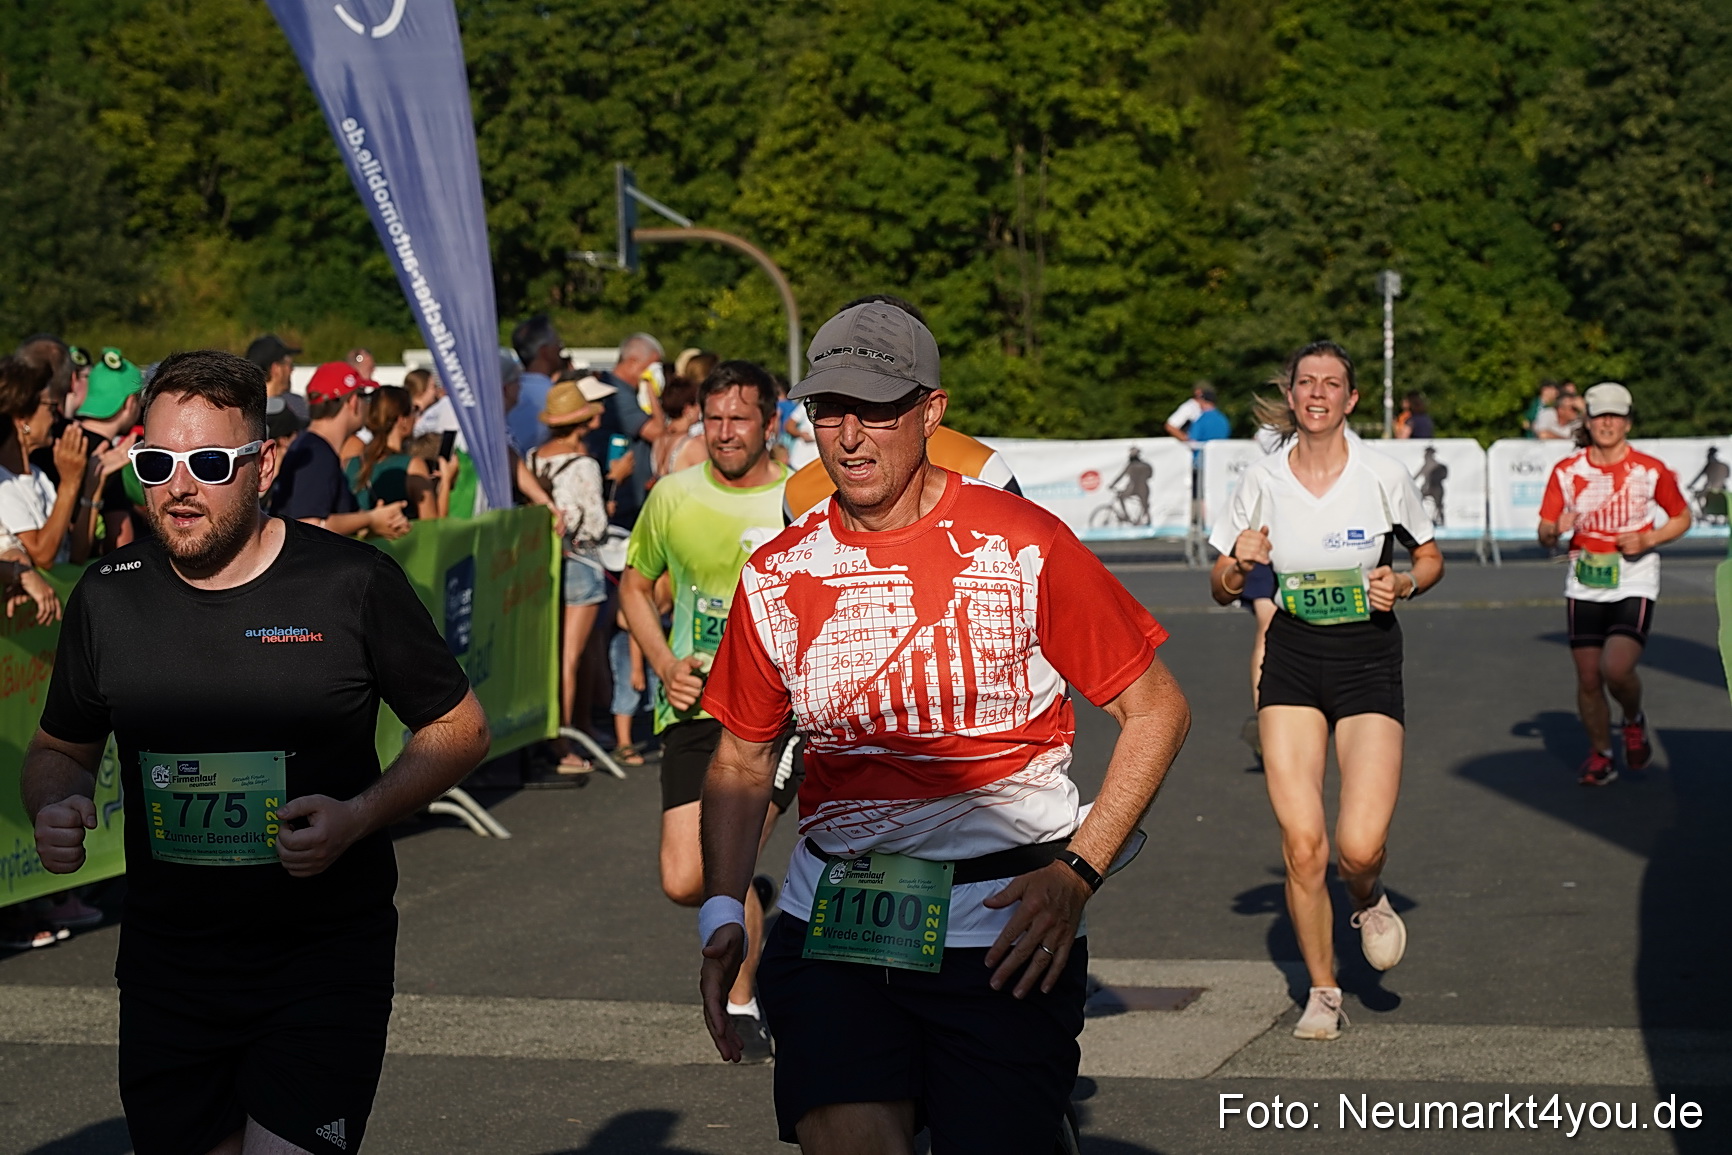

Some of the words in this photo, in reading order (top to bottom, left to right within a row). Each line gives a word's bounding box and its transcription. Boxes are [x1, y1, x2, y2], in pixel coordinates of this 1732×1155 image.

[813, 346, 854, 363] SILVER
[857, 347, 896, 364] STAR
[114, 560, 142, 572] JAKO
[832, 559, 868, 576] 10.54
[970, 560, 1020, 577] 91.62%
[1303, 586, 1346, 607] 516
[245, 626, 309, 637] autoladen
[261, 632, 323, 643] neumarkt
[831, 628, 872, 646] 52.01
[831, 651, 874, 670] 26.22
[172, 772, 217, 784] Firmenlauf
[188, 780, 217, 788] neumarkt
[172, 792, 248, 829] 775
[152, 802, 165, 839] RUN
[265, 797, 280, 848] 2022
[164, 829, 204, 844] Zunner
[206, 831, 266, 844] Benedikt
[845, 870, 886, 880] Firmenlauf
[812, 899, 828, 937] RUN
[831, 887, 923, 932] 1100
[822, 926, 859, 941] Wrede
[861, 929, 922, 949] Clemens
[922, 903, 942, 956] 2022
[315, 1127, 348, 1151] adidas
